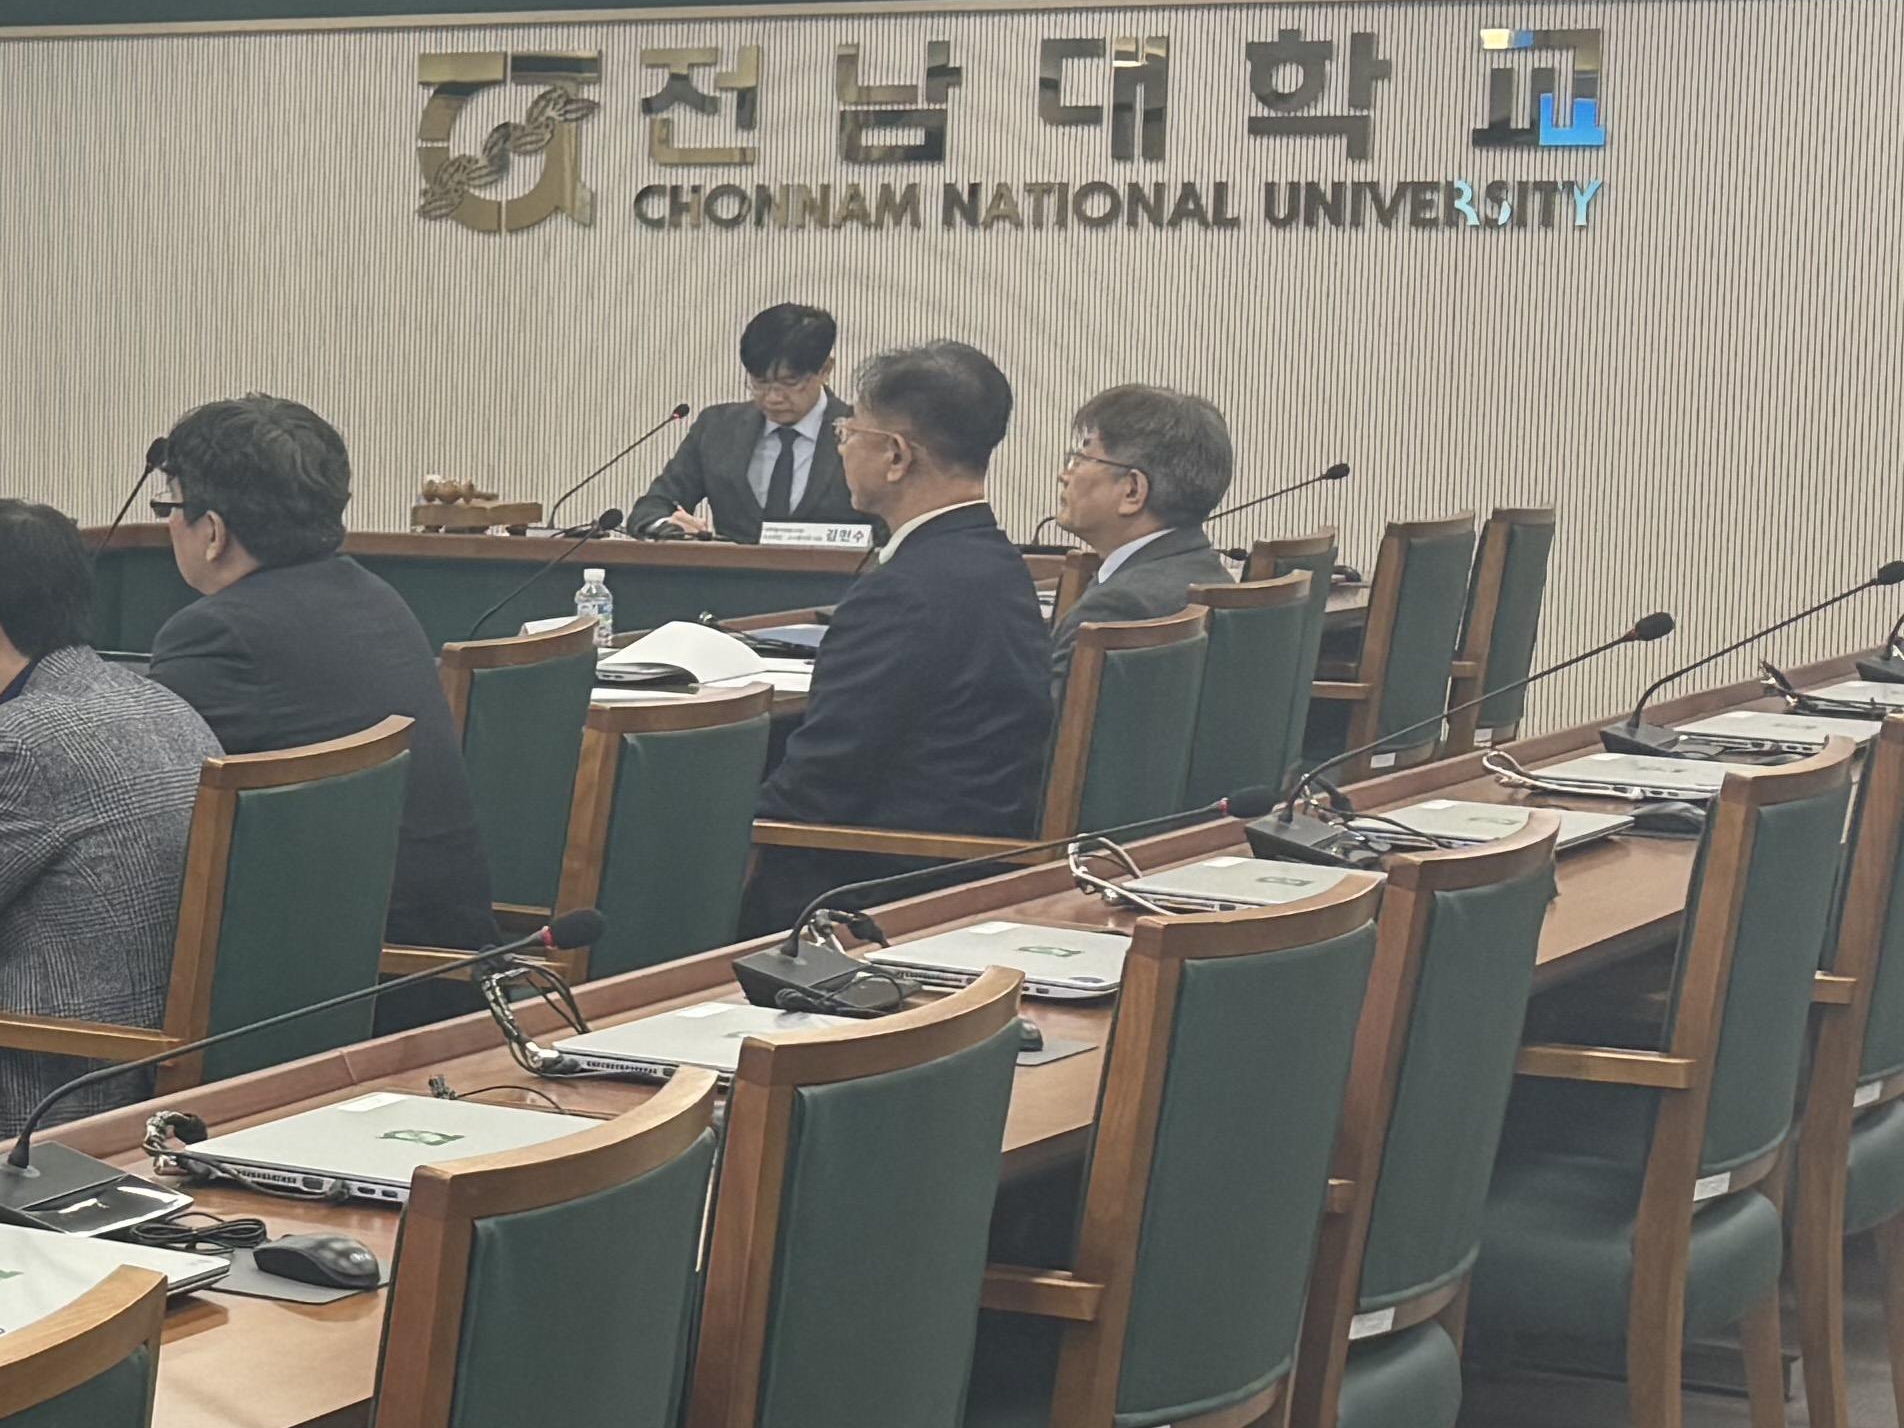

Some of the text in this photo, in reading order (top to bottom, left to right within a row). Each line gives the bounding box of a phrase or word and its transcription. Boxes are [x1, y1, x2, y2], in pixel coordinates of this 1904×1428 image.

[640, 27, 1606, 166] 전남대학교
[633, 178, 1604, 229] CHONNAM NATIONAL UNIVERSITY
